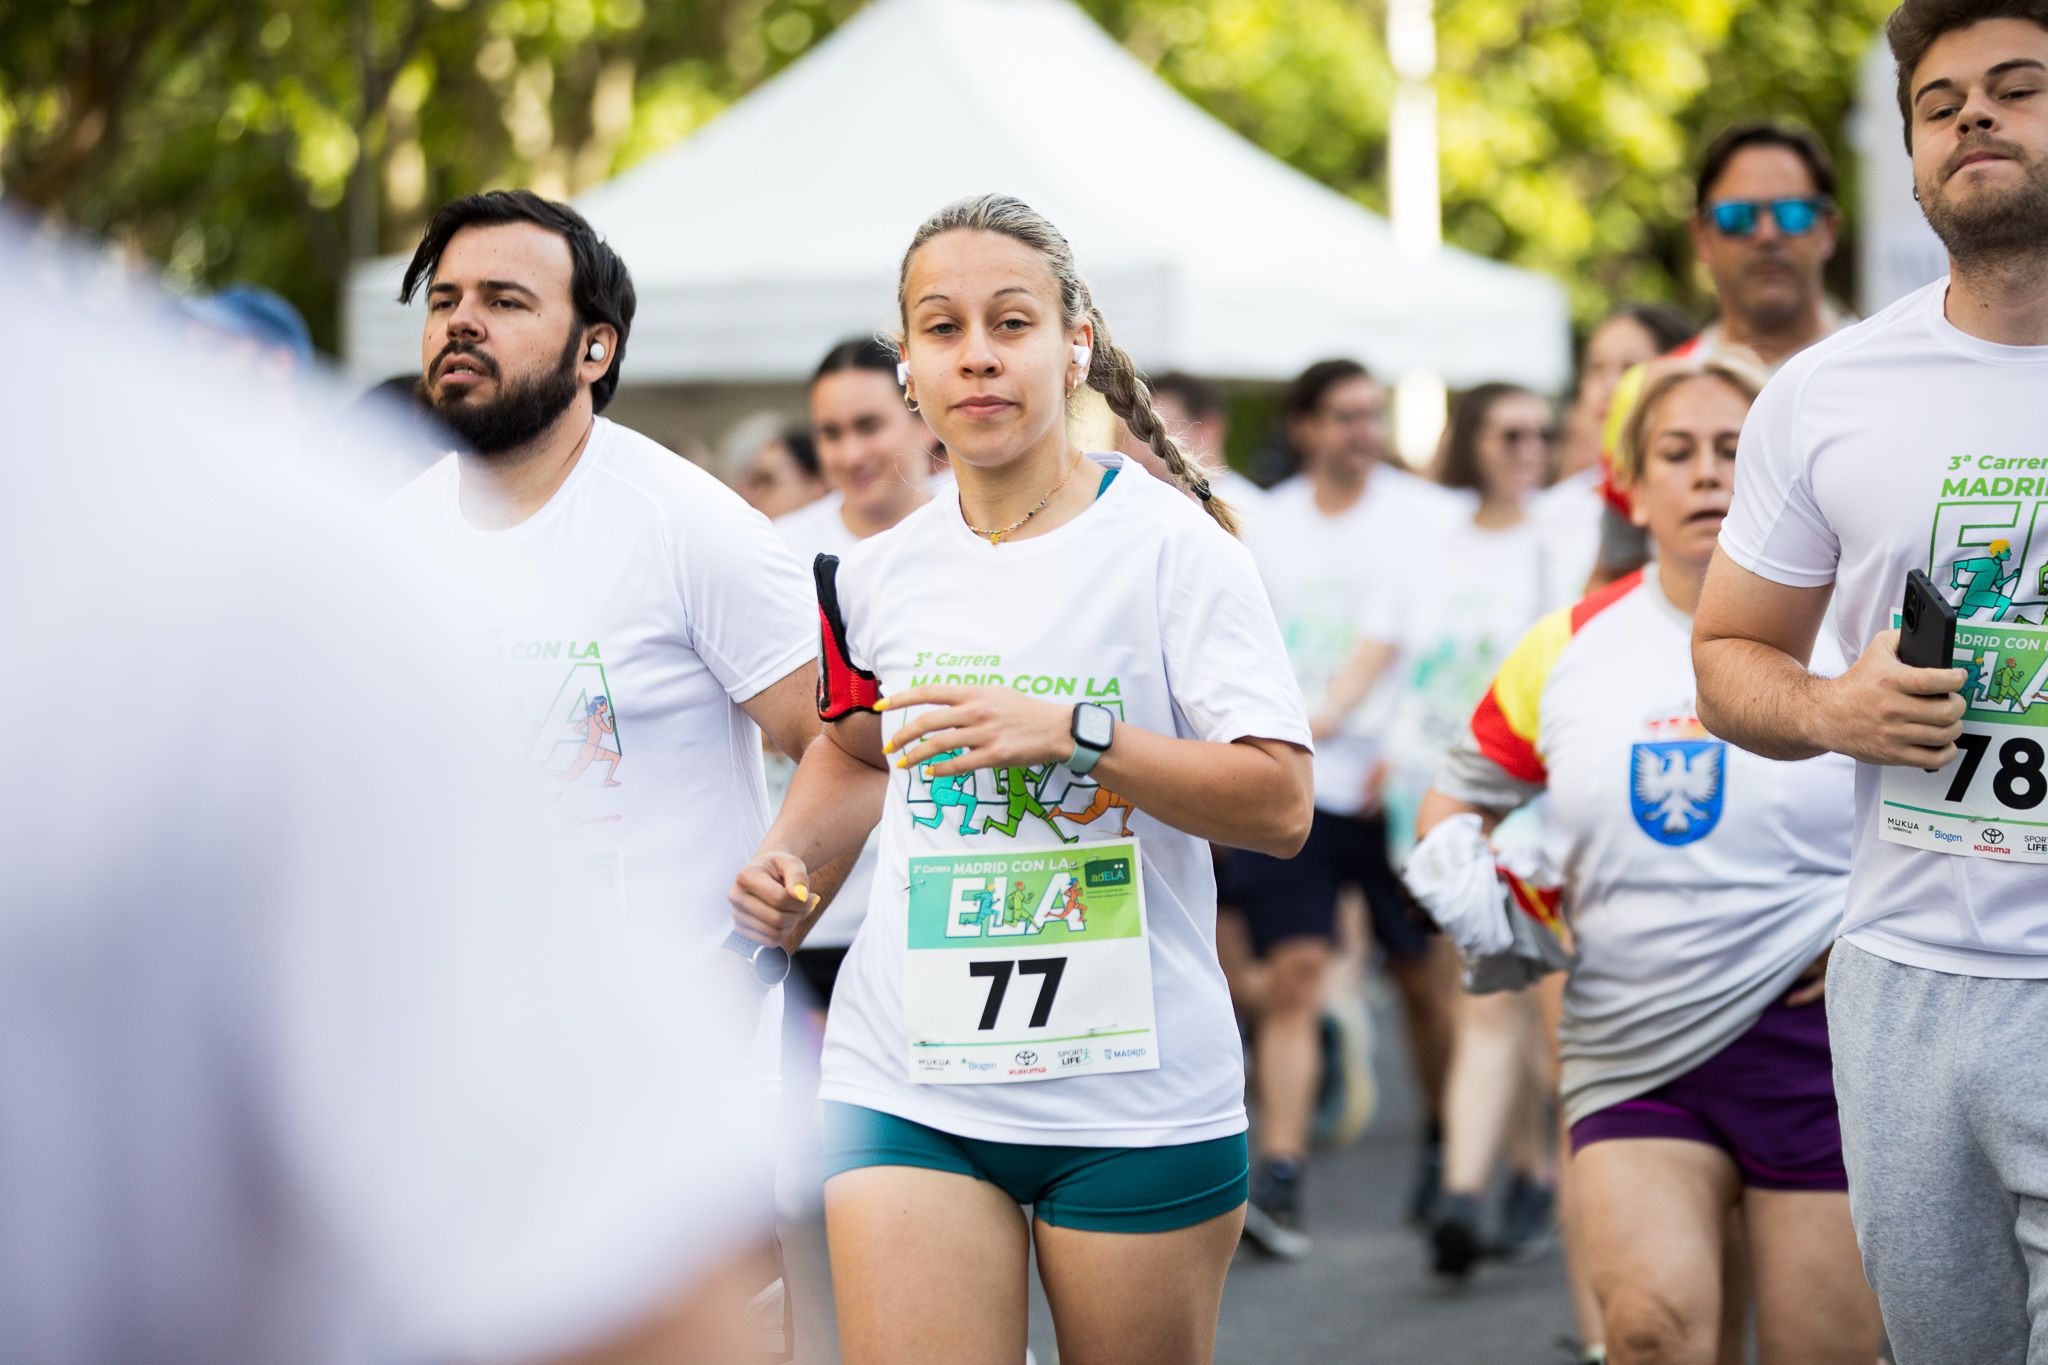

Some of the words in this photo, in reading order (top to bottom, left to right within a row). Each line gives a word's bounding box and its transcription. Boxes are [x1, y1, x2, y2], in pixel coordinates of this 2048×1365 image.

[1941, 476, 2048, 497] MADRI
[1954, 632, 2000, 648] ADRID
[2005, 637, 2041, 651] CON
[568, 640, 601, 660] LA
[935, 652, 1001, 667] Carrera
[1012, 674, 1077, 696] CON
[1085, 677, 1120, 697] LA
[1945, 733, 2048, 811] 78
[1887, 817, 1920, 831] MUKUA
[1935, 829, 1963, 843] Biogen
[2024, 834, 2048, 844] SPOR
[2027, 843, 2048, 852] LIFE
[923, 864, 951, 874] Carrera
[954, 860, 1008, 875] MADRID
[1011, 859, 1045, 873] CON
[1048, 858, 1069, 870] LA
[945, 872, 1087, 939] ELA
[969, 956, 1068, 1031] 77
[1058, 1048, 1084, 1058] SPORT
[1114, 1047, 1147, 1058] MADRID
[1062, 1056, 1082, 1066] LIFE
